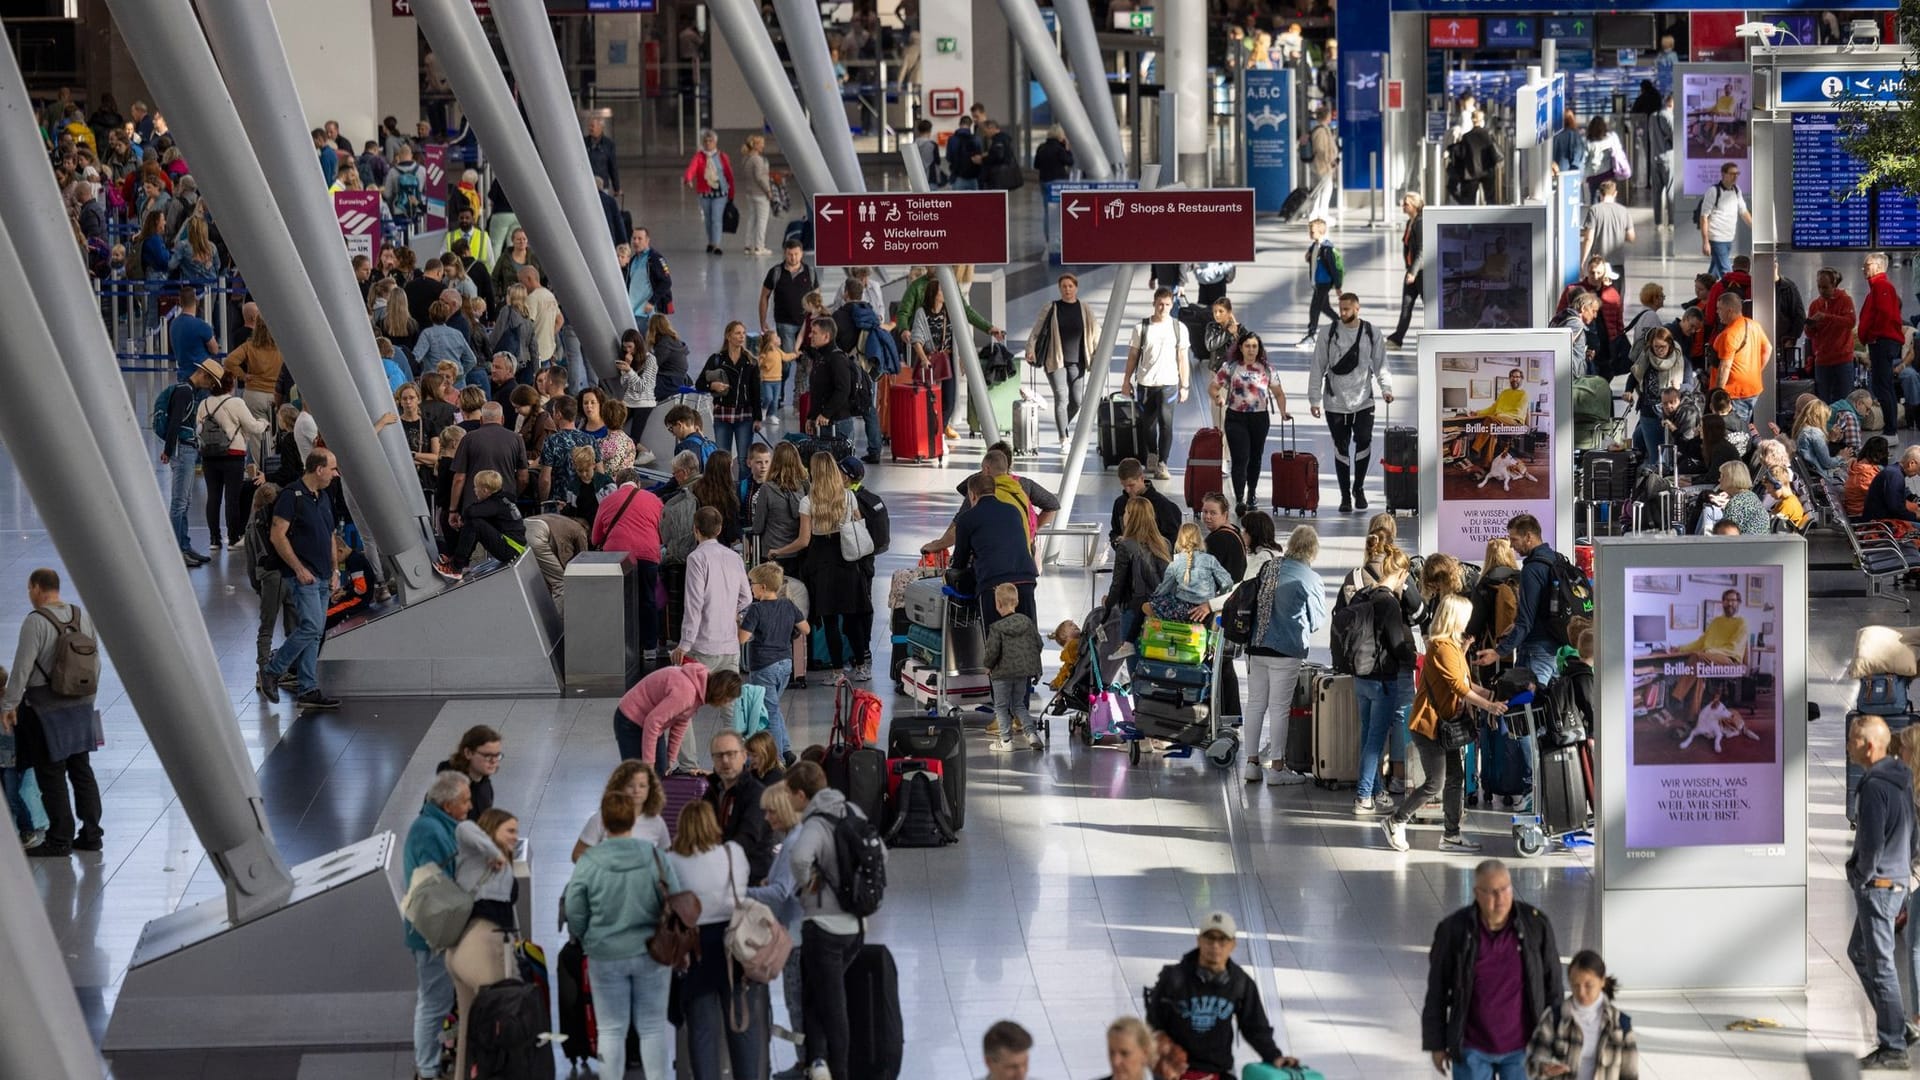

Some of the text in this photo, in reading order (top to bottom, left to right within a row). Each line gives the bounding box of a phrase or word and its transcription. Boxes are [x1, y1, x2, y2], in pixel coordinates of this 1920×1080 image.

[905, 199, 952, 209] Toiletten
[1130, 203, 1242, 215] Shops & Restaurants
[906, 211, 939, 221] Toilets
[883, 228, 947, 238] Wickelraum
[884, 241, 939, 253] Baby room
[1465, 423, 1489, 433] Brille:
[1470, 518, 1480, 526] DU
[1461, 526, 1481, 534] WEIL
[1484, 526, 1500, 534] WIR
[1664, 661, 1746, 676] Brille: Fielmann.
[1661, 777, 1748, 788] WIR WISSEN, WAS
[1669, 789, 1739, 799] DU BRAUCHST.
[1658, 800, 1685, 810] WEIL
[1688, 800, 1709, 810] WIR
[1669, 811, 1740, 821] WER DU BIST.
